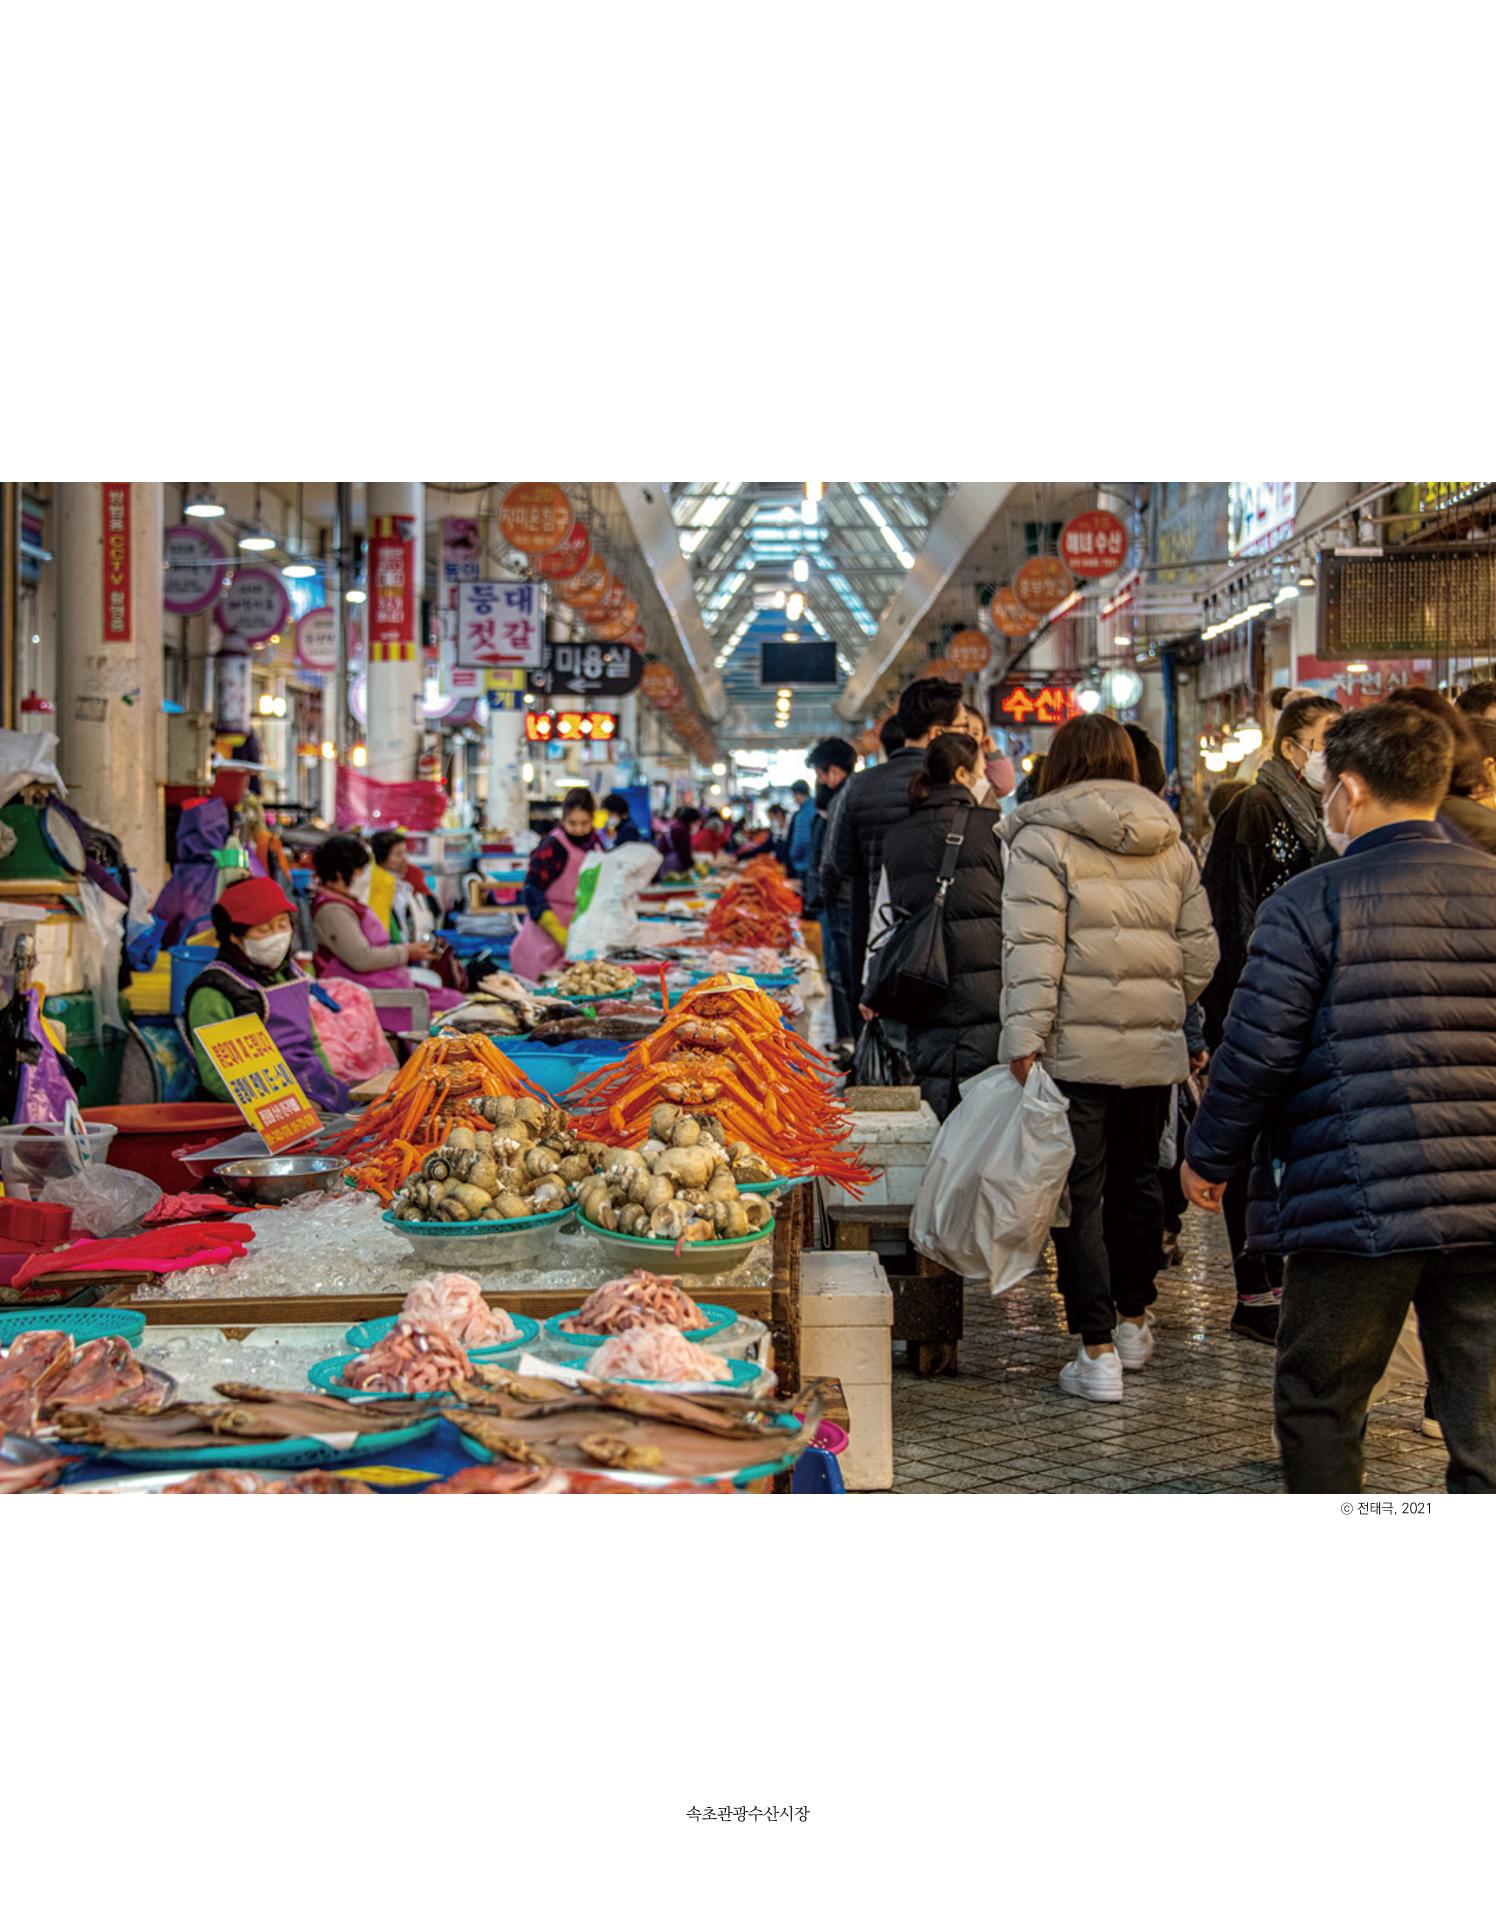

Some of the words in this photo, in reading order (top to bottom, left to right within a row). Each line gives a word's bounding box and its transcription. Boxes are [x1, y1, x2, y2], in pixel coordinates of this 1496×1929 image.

[109, 534, 126, 585] CCTV
[467, 585, 534, 615] 등대
[468, 619, 535, 650] 젓갈
[555, 645, 631, 680] 미용실
